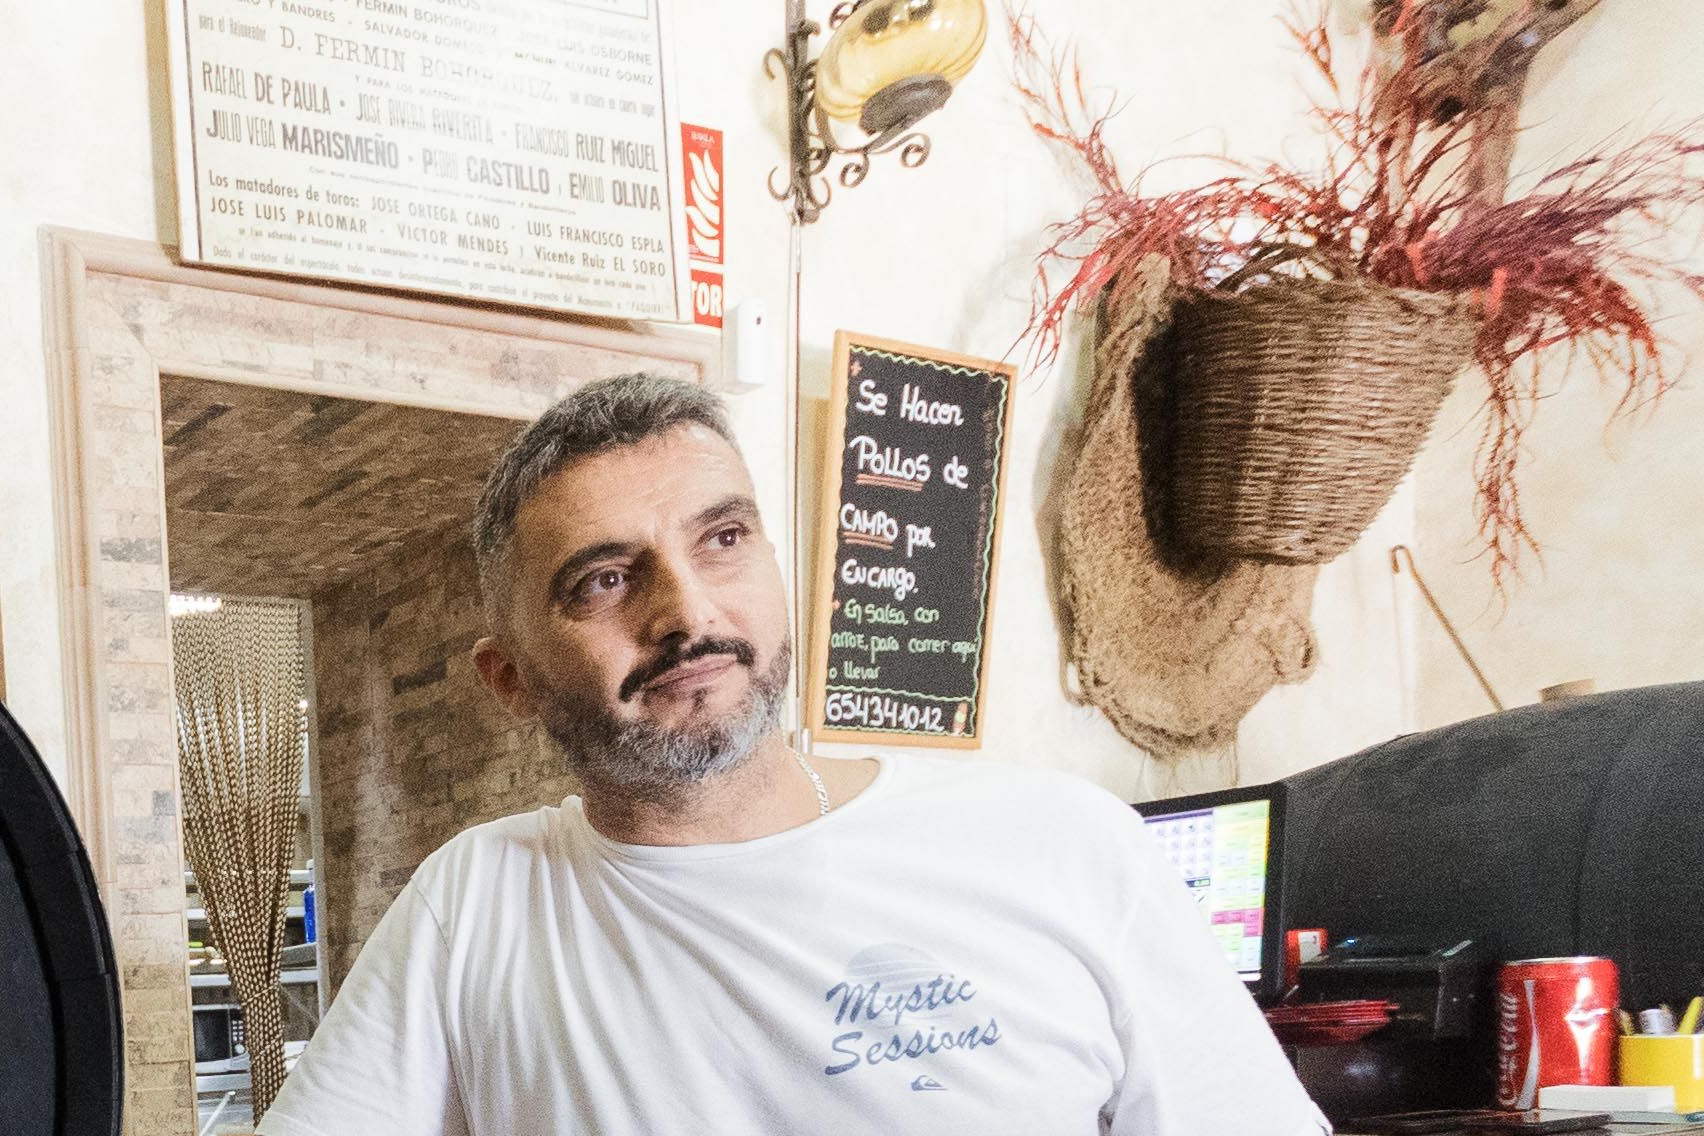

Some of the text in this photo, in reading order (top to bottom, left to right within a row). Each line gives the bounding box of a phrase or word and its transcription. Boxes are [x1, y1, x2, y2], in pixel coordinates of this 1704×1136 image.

[279, 24, 302, 51] D.
[313, 31, 406, 74] FERMIN
[363, 18, 428, 43] SALVADOR
[201, 60, 248, 100] RAFAEL
[253, 70, 274, 105] DE
[280, 75, 331, 115] PAULA
[575, 130, 605, 163] RUIZ
[610, 137, 659, 173] MIGUEL
[206, 107, 242, 143] JULIO
[246, 114, 276, 149] VEGA
[280, 116, 400, 170] MARISMEÑO
[466, 154, 550, 195] CASTILLO
[611, 178, 661, 212] OLIVA
[208, 168, 229, 188] Los
[235, 171, 299, 199] matadores
[305, 182, 319, 202] de
[325, 188, 360, 209] toros:
[371, 194, 400, 215] JOSE
[407, 200, 458, 224] ORTEGA
[465, 209, 500, 230] CANO
[527, 218, 552, 238] LUIS
[559, 223, 624, 249] FRANCISCO
[630, 234, 664, 255] ESPLA
[210, 194, 244, 217] JOSE
[255, 201, 286, 223] LUIS
[296, 207, 367, 235] PALOMAR
[396, 222, 448, 246] VICTOR
[457, 232, 509, 256] MENDES
[534, 243, 575, 266] Vicente
[581, 251, 606, 270] Ruiz
[612, 254, 625, 272] EL
[632, 257, 666, 278] SORO
[856, 379, 887, 417] Se
[943, 461, 970, 490] de
[840, 501, 899, 542] CAMPO
[913, 606, 941, 625] con
[907, 637, 951, 656] comer
[827, 667, 838, 681] o
[825, 692, 945, 734] 654341012
[825, 973, 978, 1027] Mystic
[823, 1016, 1003, 1077] Sessions
